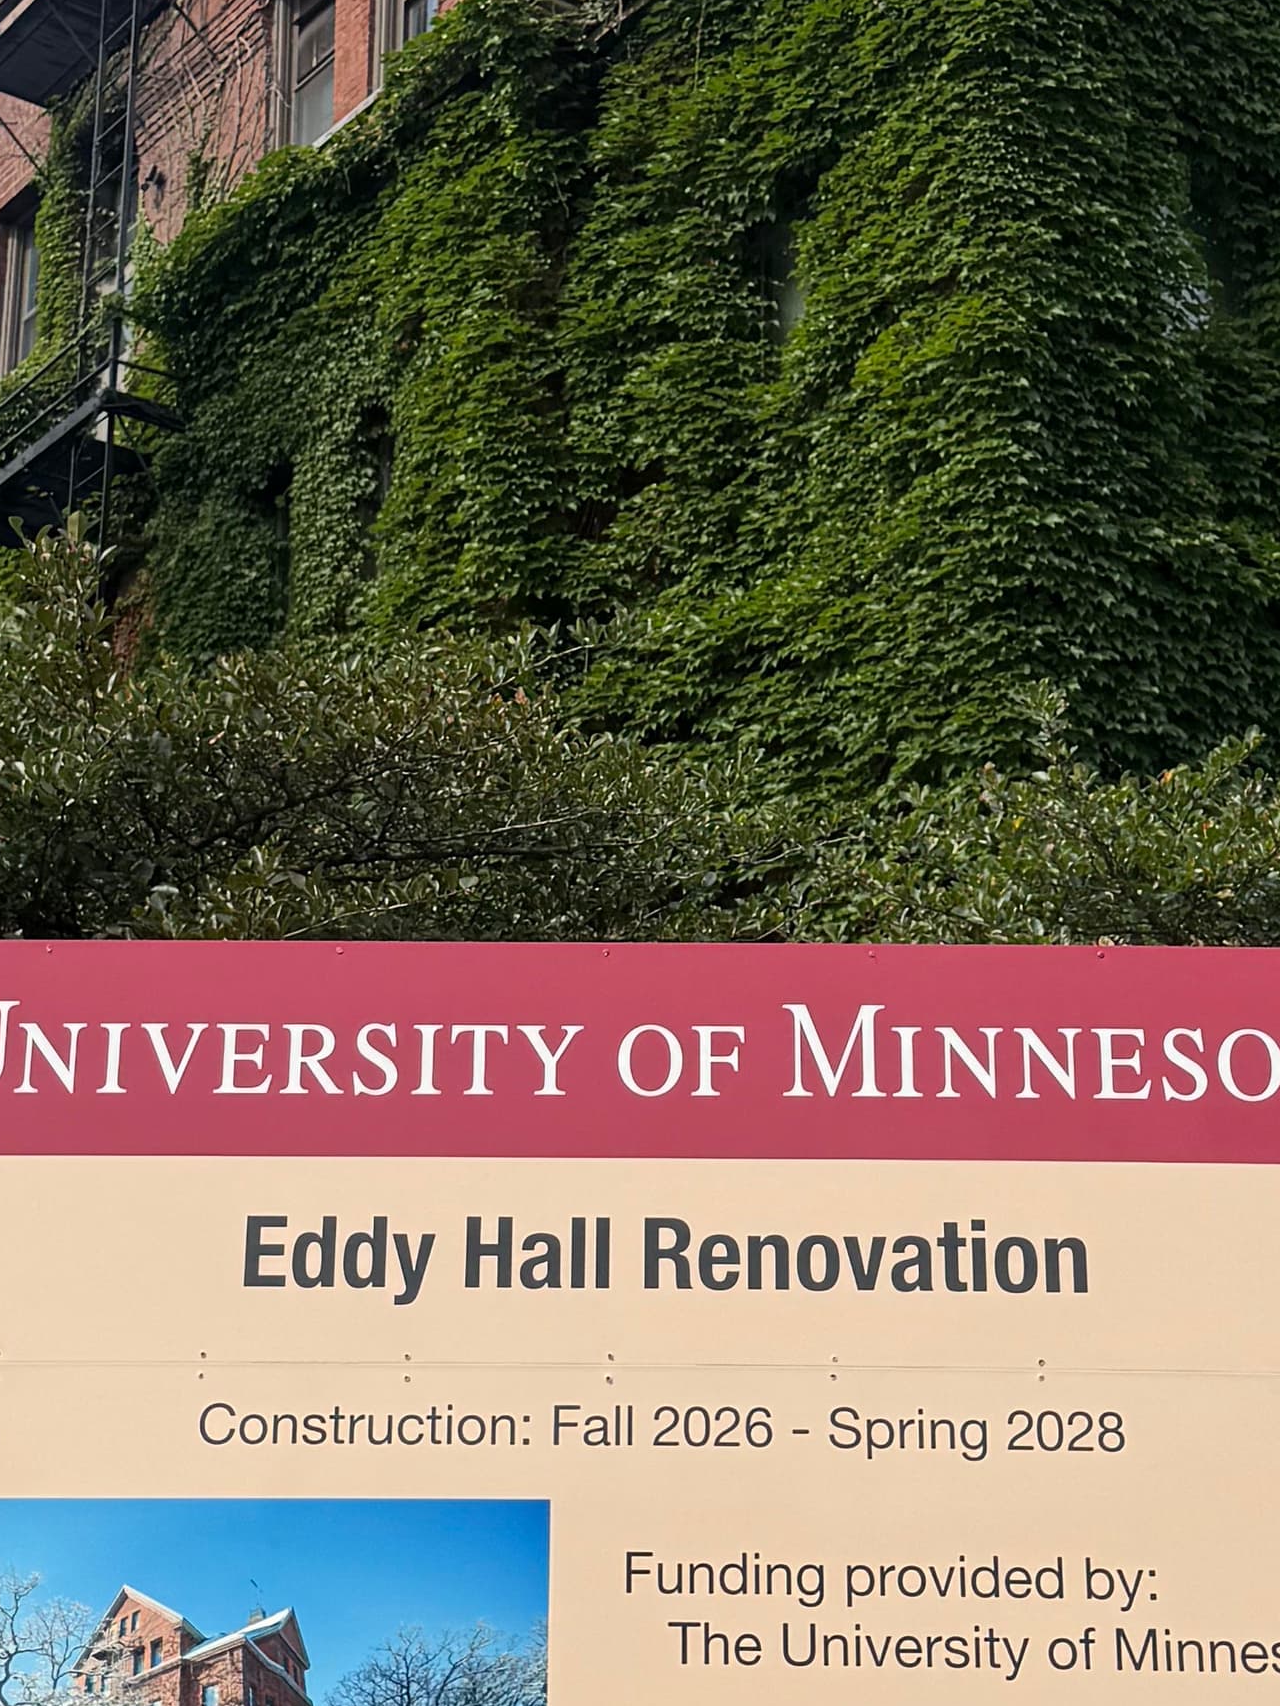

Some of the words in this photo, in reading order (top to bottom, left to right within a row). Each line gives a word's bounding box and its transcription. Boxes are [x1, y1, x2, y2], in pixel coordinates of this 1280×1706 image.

[617, 1024, 745, 1097] OF
[242, 1215, 437, 1306] Eddy
[464, 1215, 611, 1290] Hall
[643, 1216, 1089, 1294] Renovation
[199, 1402, 531, 1446] Construction:
[553, 1404, 633, 1447] Fall
[652, 1405, 773, 1448] 2026
[828, 1406, 988, 1462] Spring
[1007, 1409, 1126, 1453] 2028
[625, 1551, 825, 1608] Funding
[846, 1554, 1065, 1608] provided
[1084, 1556, 1158, 1613] by:
[667, 1621, 763, 1667] The
[782, 1622, 1030, 1682] University
[1047, 1626, 1097, 1671] of
